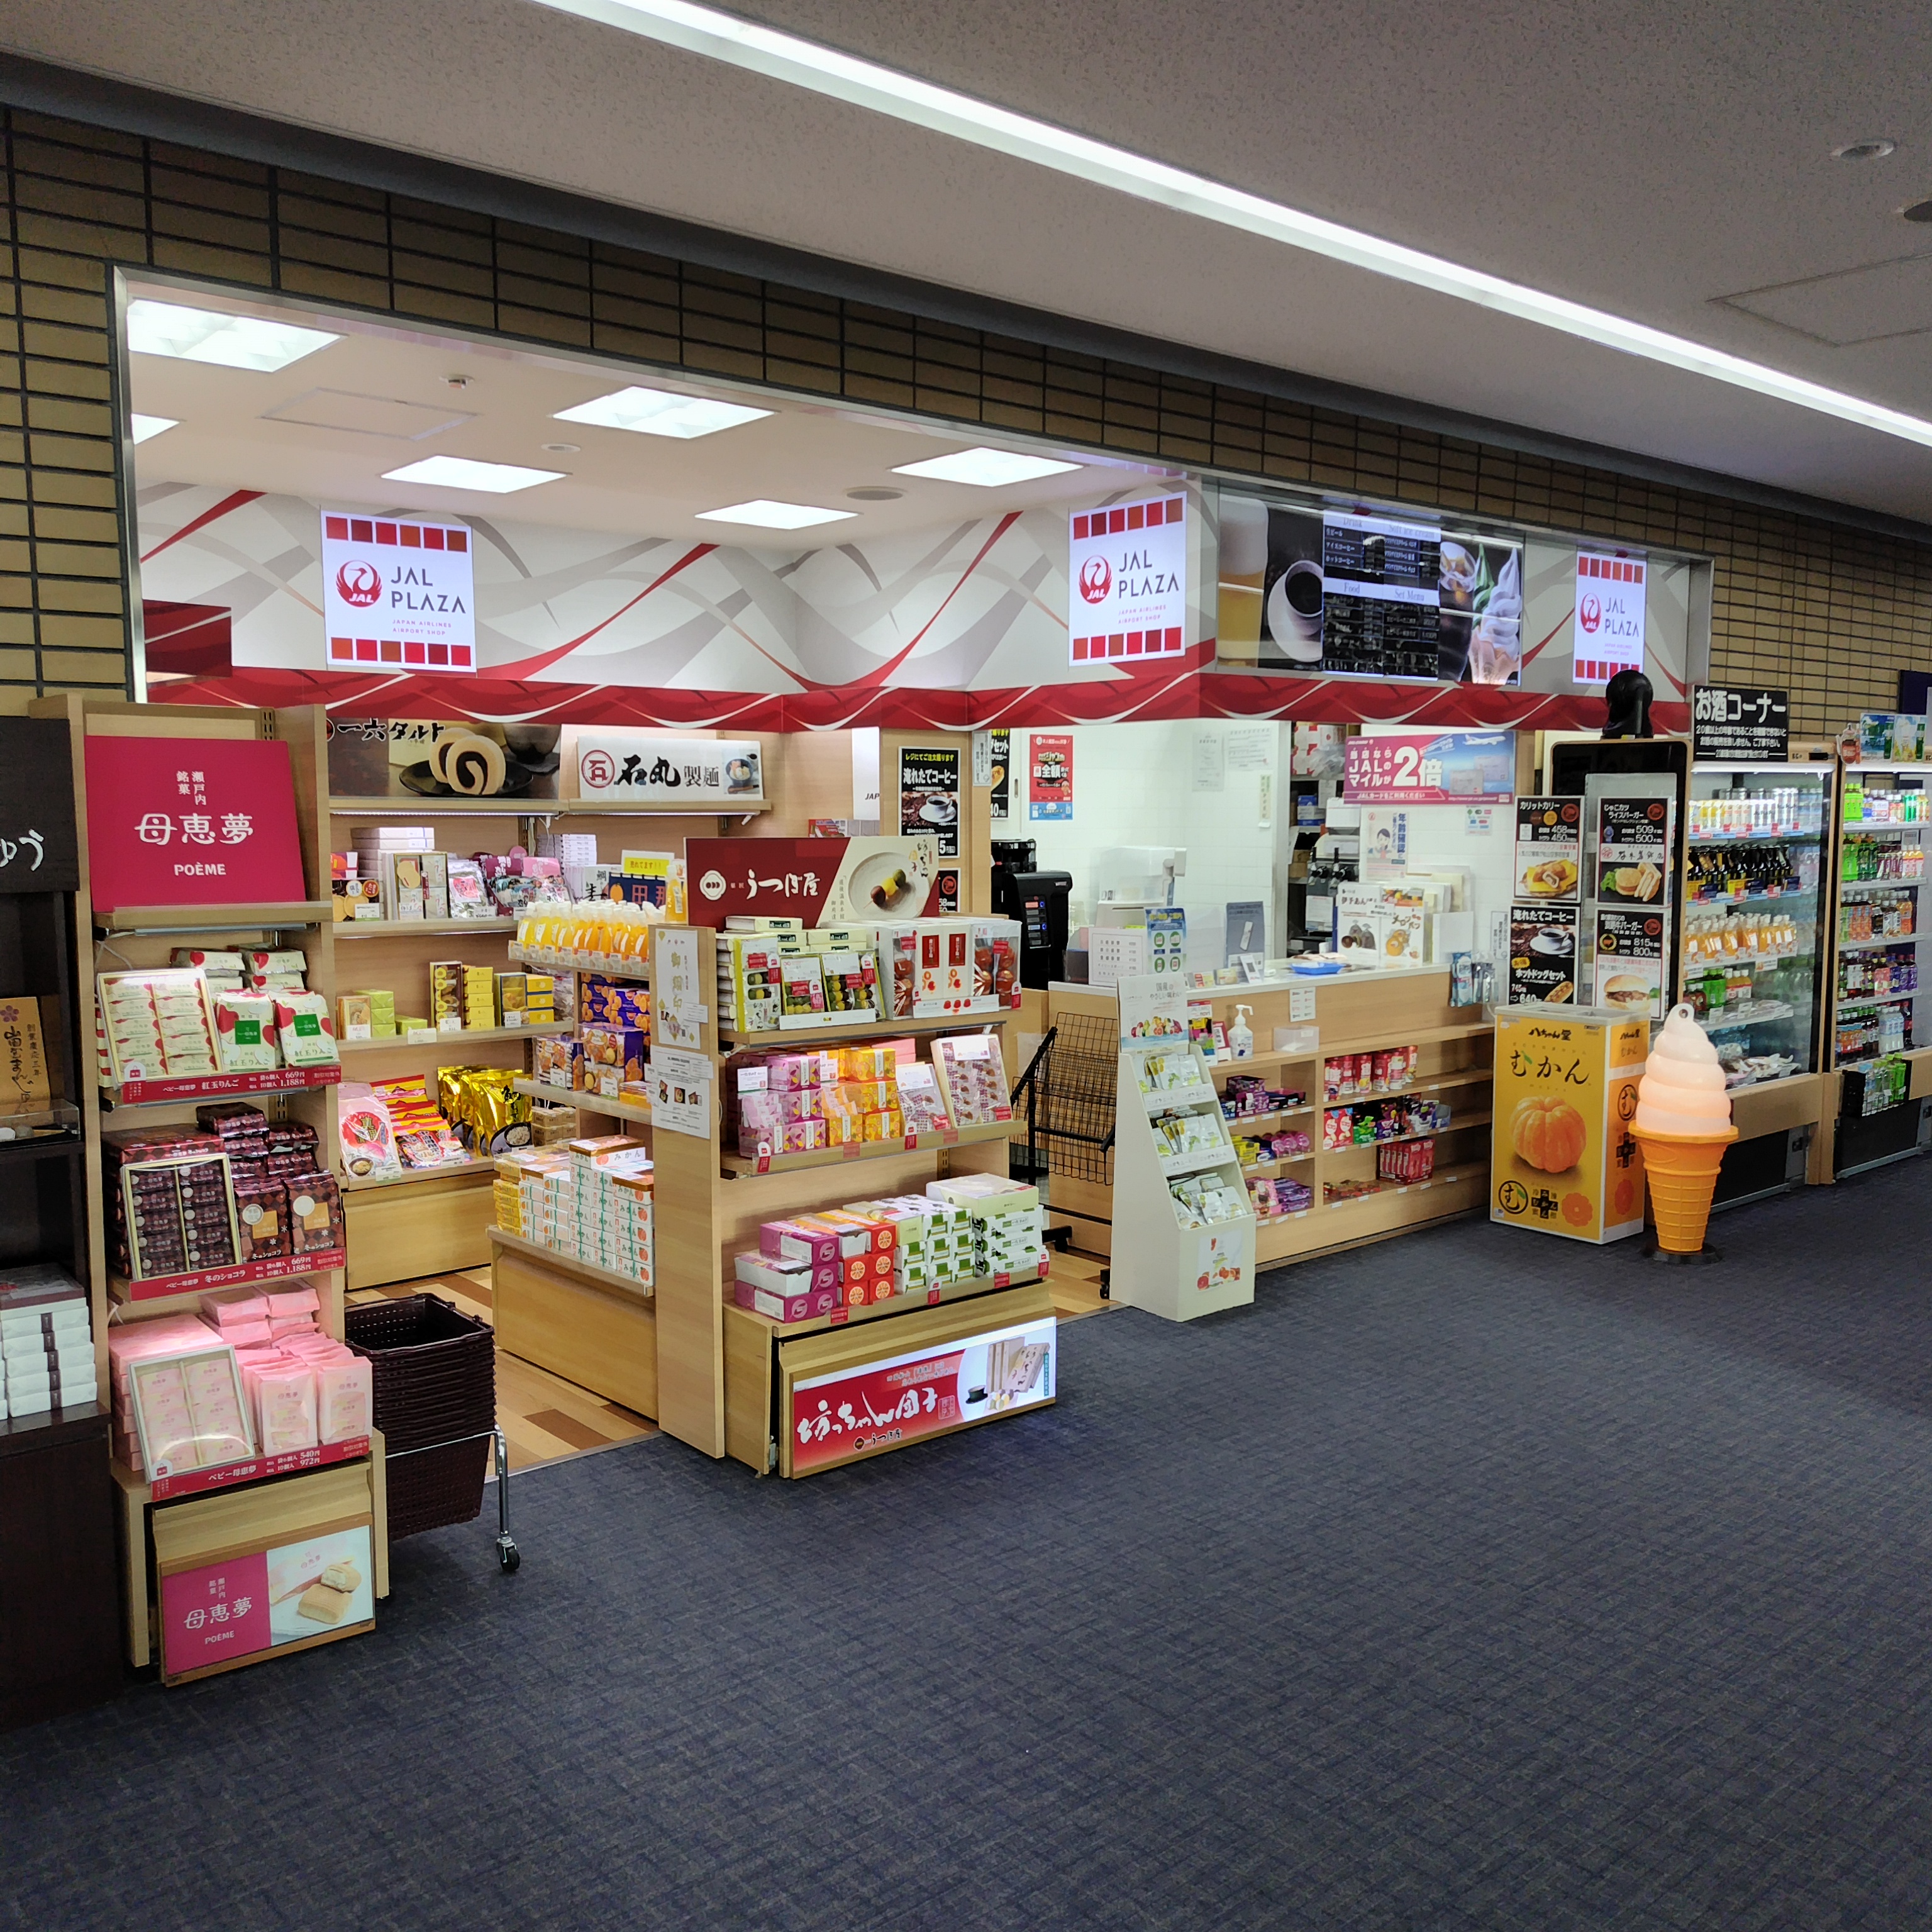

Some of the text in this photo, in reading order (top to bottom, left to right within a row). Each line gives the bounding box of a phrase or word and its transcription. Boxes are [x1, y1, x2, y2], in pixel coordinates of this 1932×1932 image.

[1119, 550, 1152, 572] JAL
[391, 566, 433, 587] JAL
[1119, 572, 1179, 599] PLAZA
[349, 593, 374, 603] JAL
[1087, 588, 1106, 600] JAL
[1343, 582, 1360, 594] Food
[391, 590, 466, 614] PLAZA
[1605, 597, 1626, 614] JAL
[1604, 618, 1640, 638] PLAZA
[1696, 688, 1786, 723] お酒コーナー
[337, 718, 445, 743] 一六タルト
[588, 760, 609, 781] 石
[1348, 760, 1392, 773] JALの
[1350, 746, 1442, 787] 当店なら 2倍
[176, 770, 191, 795] 銘菓
[191, 770, 207, 806] 瀬戸内
[1348, 774, 1392, 787] マイルが
[1519, 801, 1560, 810] カリットカリー
[134, 813, 253, 845] 母恵夢
[1551, 825, 1567, 834] 458
[1635, 835, 1653, 843] 500
[1636, 825, 1654, 834] 509
[174, 862, 226, 876] POÈME
[747, 869, 820, 900] うつぼ屋
[1633, 938, 1650, 947] 815
[1633, 947, 1650, 956] 800
[1528, 1028, 1571, 1041] 八ちゃん堂
[1510, 1050, 1589, 1084] むかん
[201, 1079, 240, 1091] 紅玉りんご
[286, 1071, 305, 1079] 669円
[614, 1150, 641, 1160] みかん
[252, 1249, 282, 1260] 冬のショコラ
[204, 1270, 246, 1283] 冬のショコラ
[291, 1257, 311, 1265] 669円
[797, 1387, 938, 1444] 坊っちゃん団子
[208, 1464, 257, 1482] ベビー母恵夢
[300, 1450, 320, 1459] 540円
[300, 1457, 320, 1467] 972円
[184, 1597, 252, 1629] 母恵夢
[205, 1630, 235, 1645] POÈME
